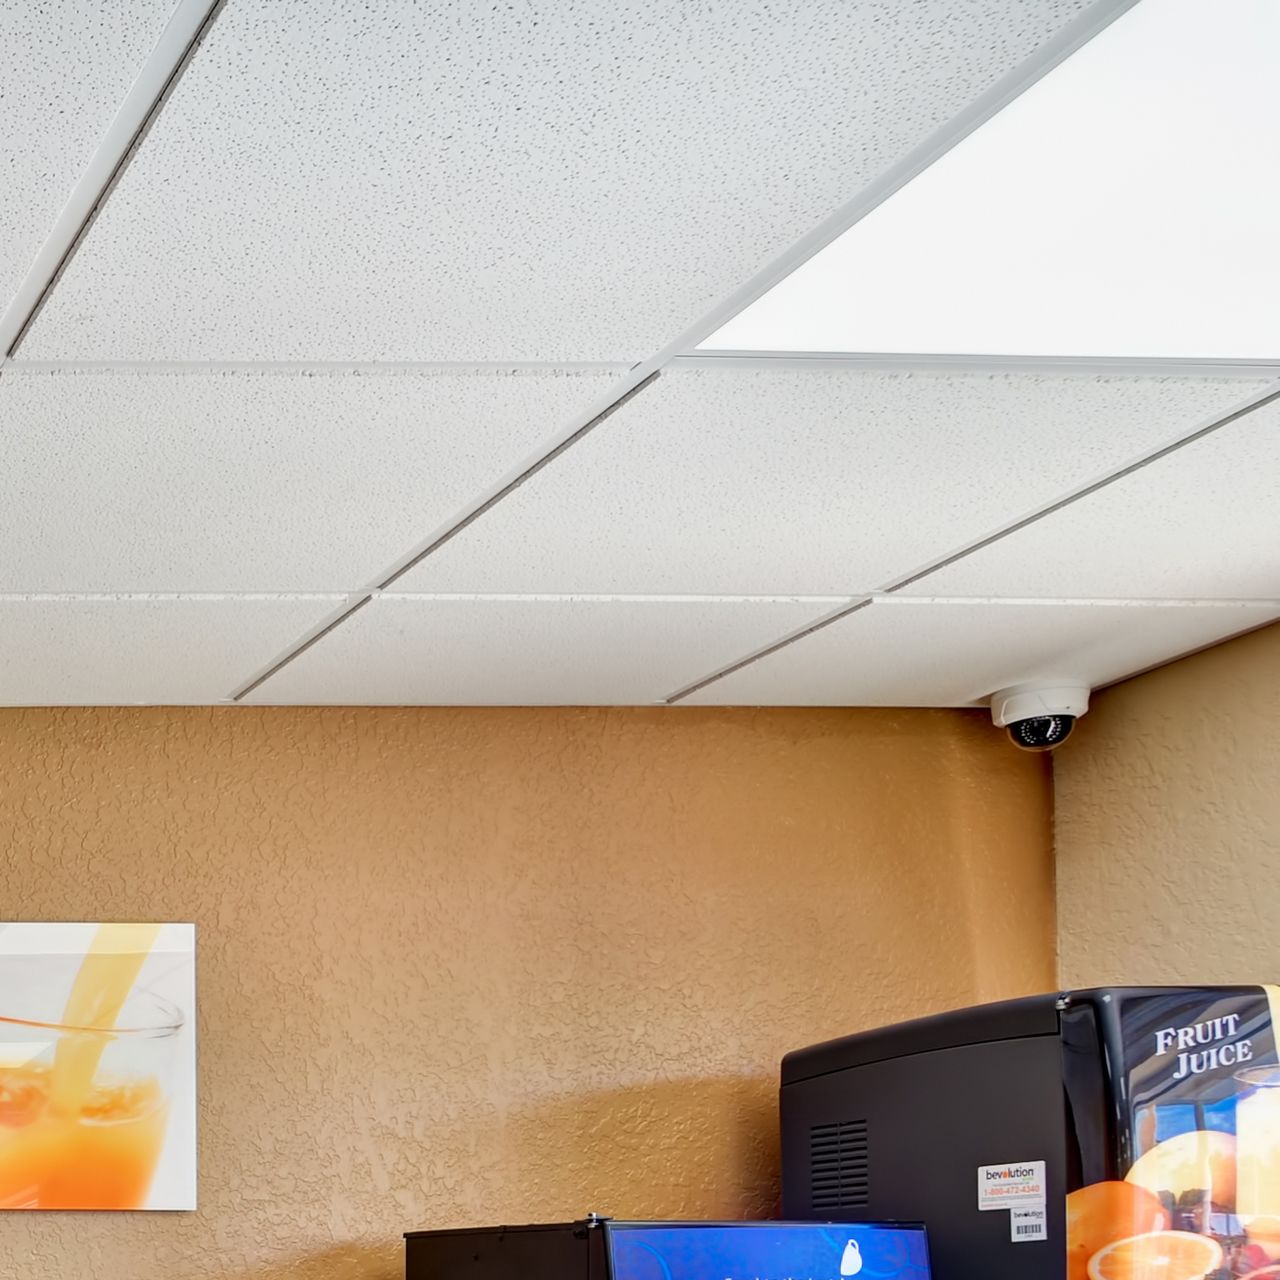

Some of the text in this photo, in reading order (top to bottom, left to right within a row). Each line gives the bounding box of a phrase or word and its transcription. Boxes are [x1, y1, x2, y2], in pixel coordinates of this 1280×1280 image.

[1154, 1013, 1240, 1056] FRUIT
[1172, 1039, 1253, 1079] JUICE
[985, 1166, 1035, 1180] bevolution
